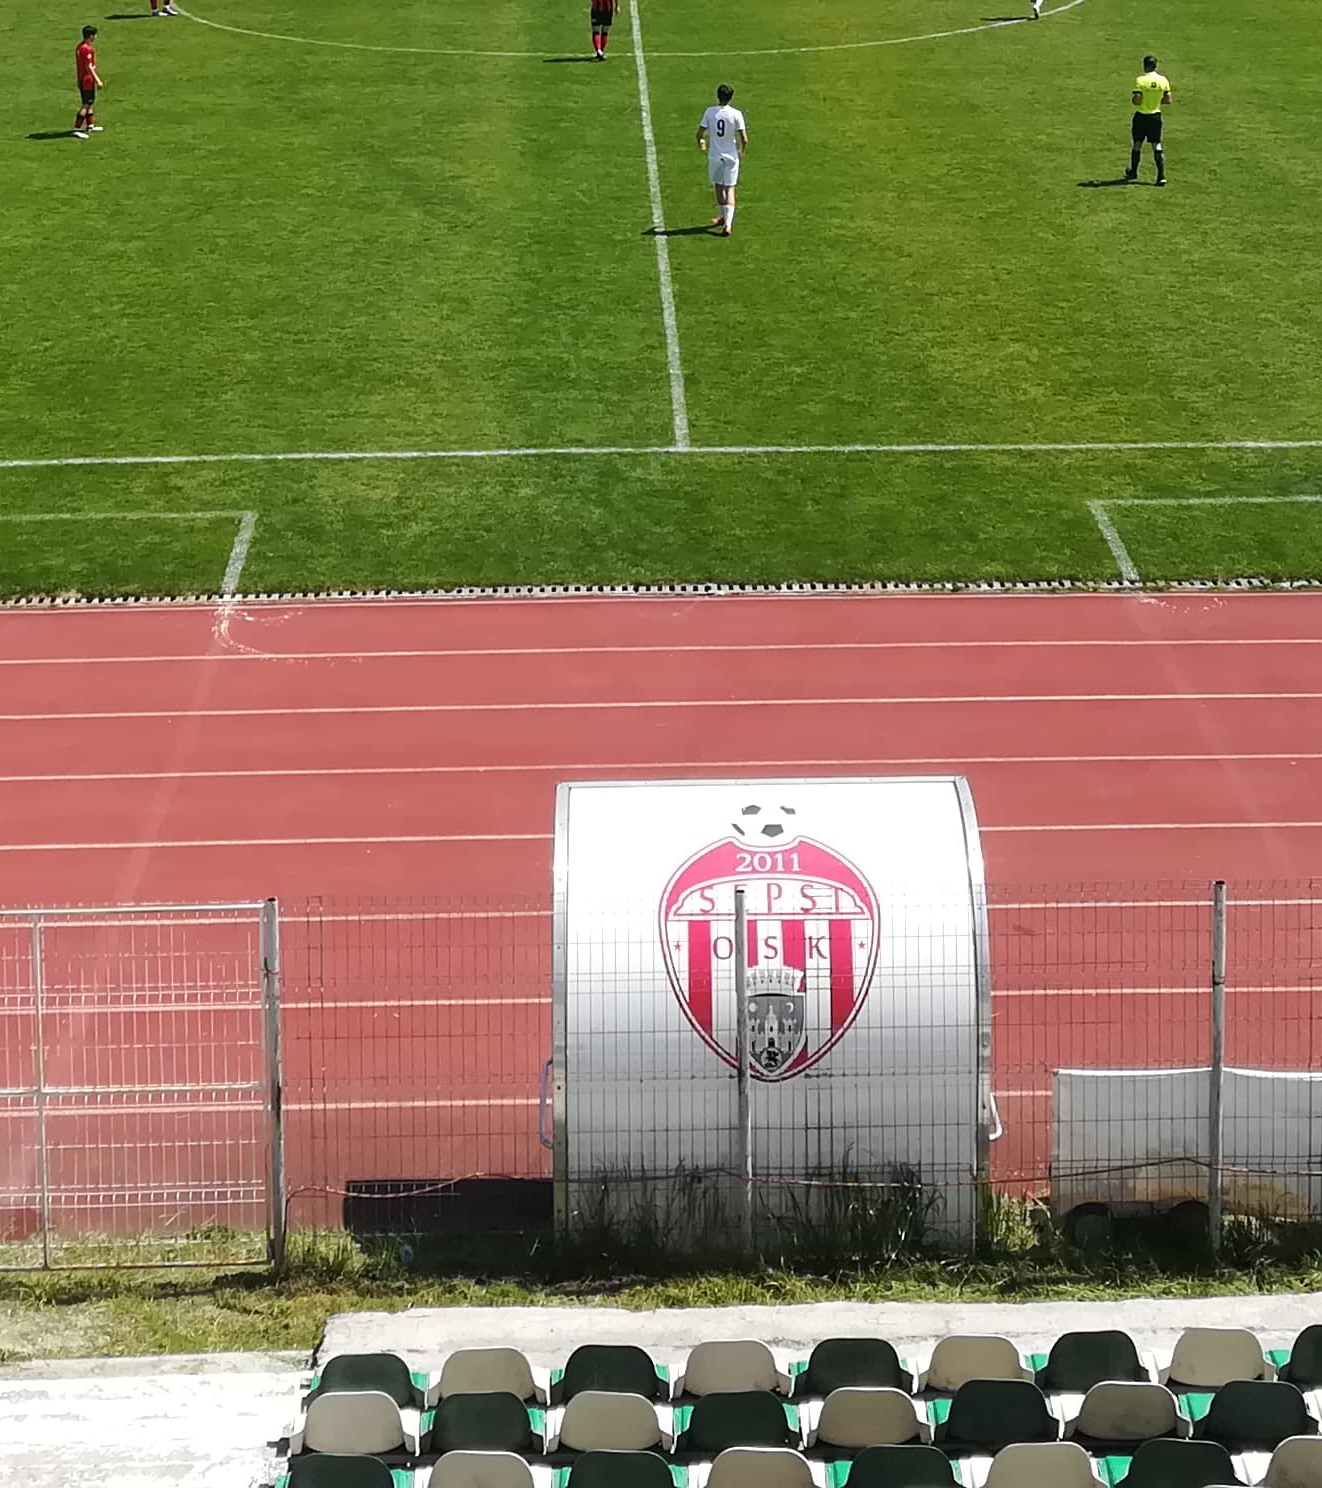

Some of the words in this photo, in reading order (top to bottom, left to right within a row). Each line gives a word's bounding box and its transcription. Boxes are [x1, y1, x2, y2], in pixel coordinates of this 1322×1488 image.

[717, 118, 725, 138] 9
[735, 852, 801, 872] 2011
[699, 882, 839, 913] SPSI
